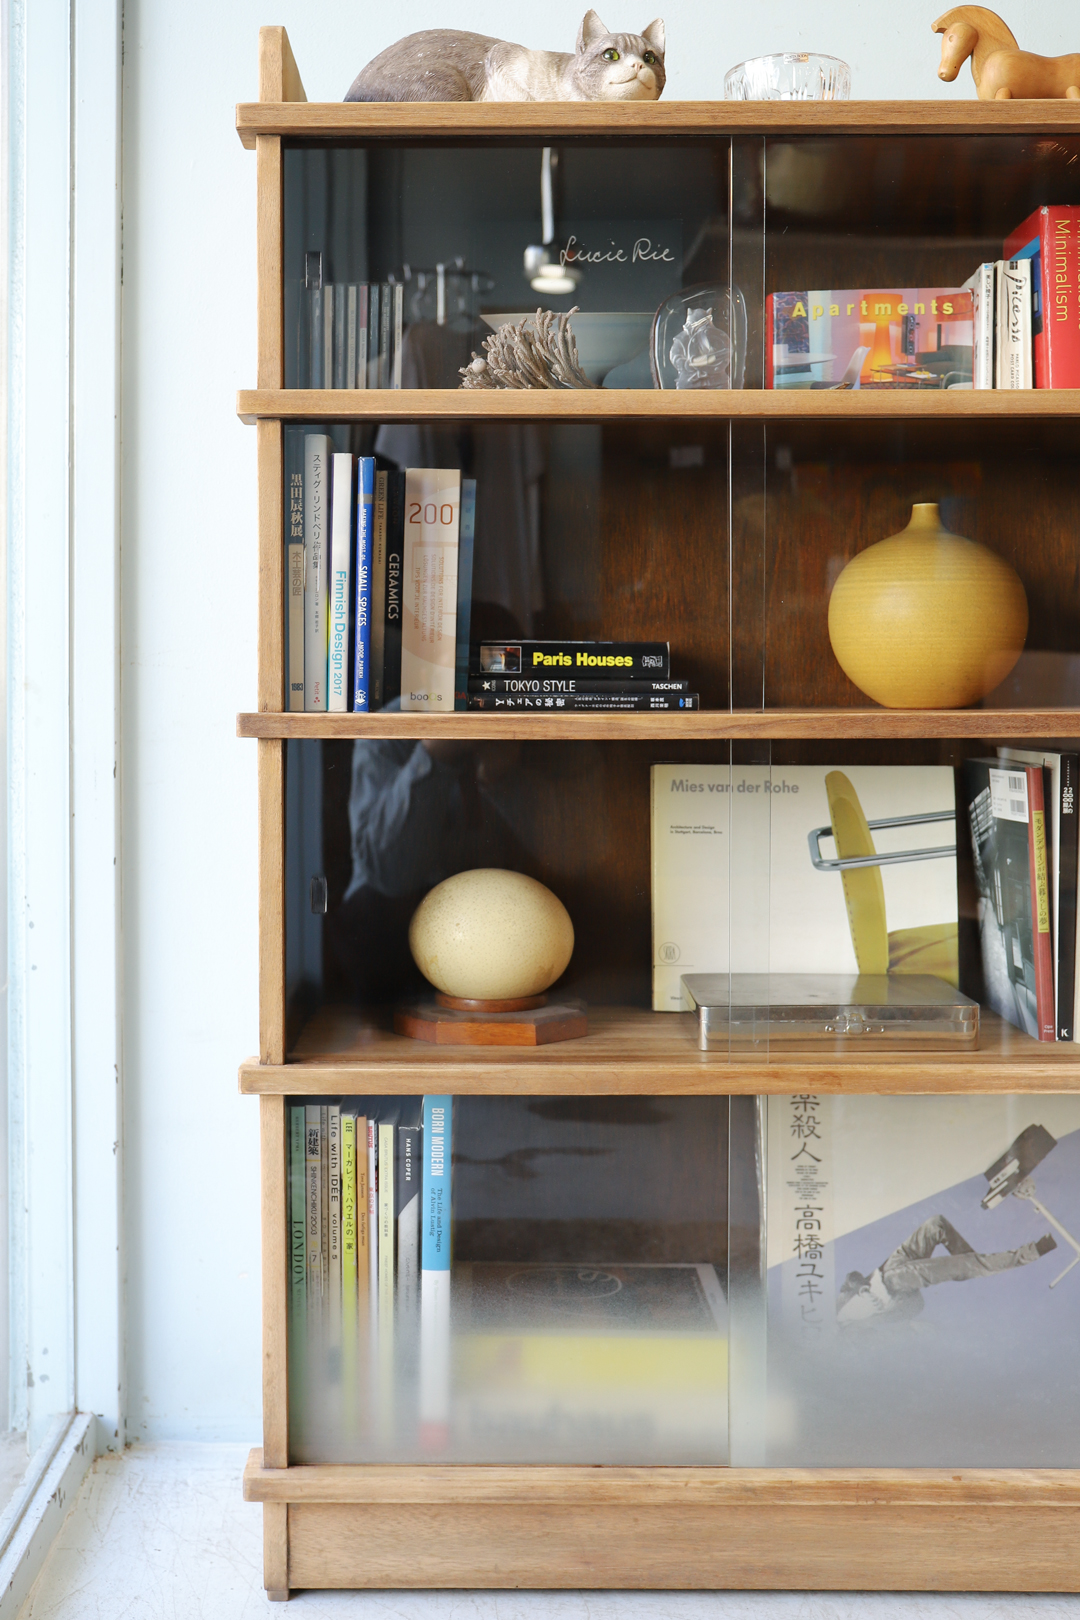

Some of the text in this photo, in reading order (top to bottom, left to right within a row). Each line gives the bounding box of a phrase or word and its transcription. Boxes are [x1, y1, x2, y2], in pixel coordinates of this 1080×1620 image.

[559, 235, 675, 266] Lucie Rie
[1055, 219, 1072, 322] Minimalism
[791, 300, 954, 320] Apartments
[1003, 272, 1027, 343] Picasso
[290, 473, 303, 537] 黒田辰秋展
[409, 502, 454, 525] 200
[292, 551, 302, 596] 木工芸の匠
[358, 566, 368, 592] SMALL
[388, 553, 399, 619] CERAMICS
[358, 597, 367, 626] SPACES
[332, 570, 347, 696] Finnish Design 2017
[532, 652, 633, 667] Paris Houses
[291, 683, 303, 692] 1983
[504, 679, 576, 692] TOKYO STYLE
[671, 779, 799, 794] Mies van der Rohe
[1061, 1028, 1069, 1038] K
[330, 1115, 338, 1138] Life
[345, 1122, 353, 1132] LEE
[308, 1129, 319, 1156] 新建築
[330, 1143, 338, 1168] with
[431, 1108, 444, 1176] BORN MODERN
[331, 1174, 340, 1202] IDÉE
[293, 1221, 304, 1285] LONDON
[311, 1254, 317, 1263] 7
[792, 1204, 825, 1334] 高橋ユキヒ
